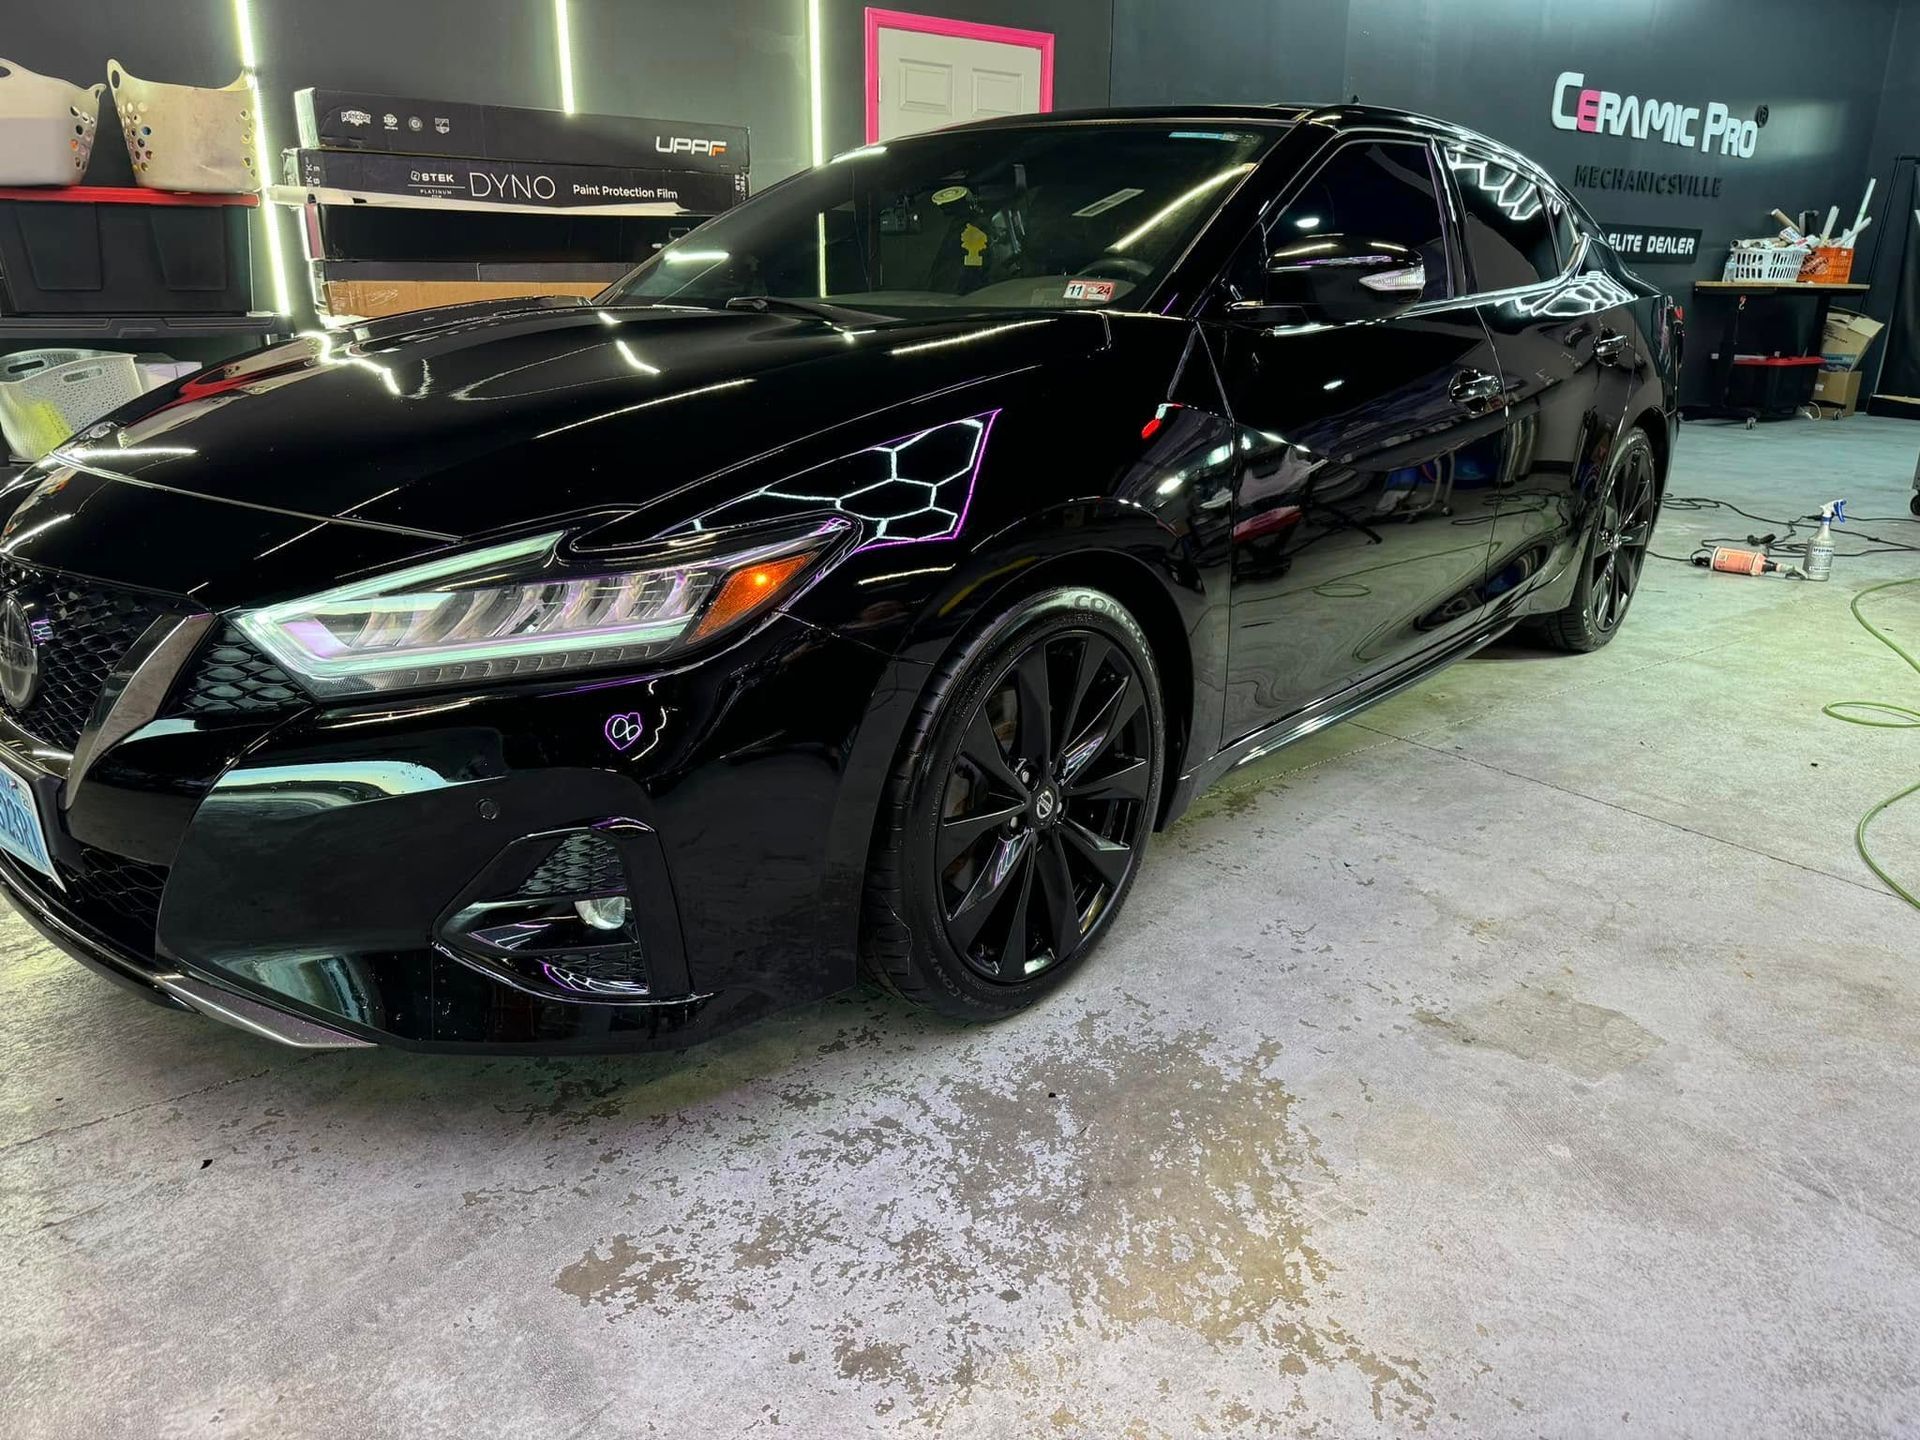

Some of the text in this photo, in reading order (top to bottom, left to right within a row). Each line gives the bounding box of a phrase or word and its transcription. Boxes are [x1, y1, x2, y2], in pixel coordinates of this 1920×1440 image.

[1551, 71, 1699, 147] CERAMIC
[655, 135, 727, 158] UPPF
[421, 172, 455, 183] STEK
[469, 172, 556, 200] DYNO
[1574, 164, 1724, 199] MECHANICSVILLE
[573, 184, 678, 199] Paint Protection Film
[1608, 233, 1695, 255] ELITE DEALER
[1070, 284, 1111, 296] 11 24
